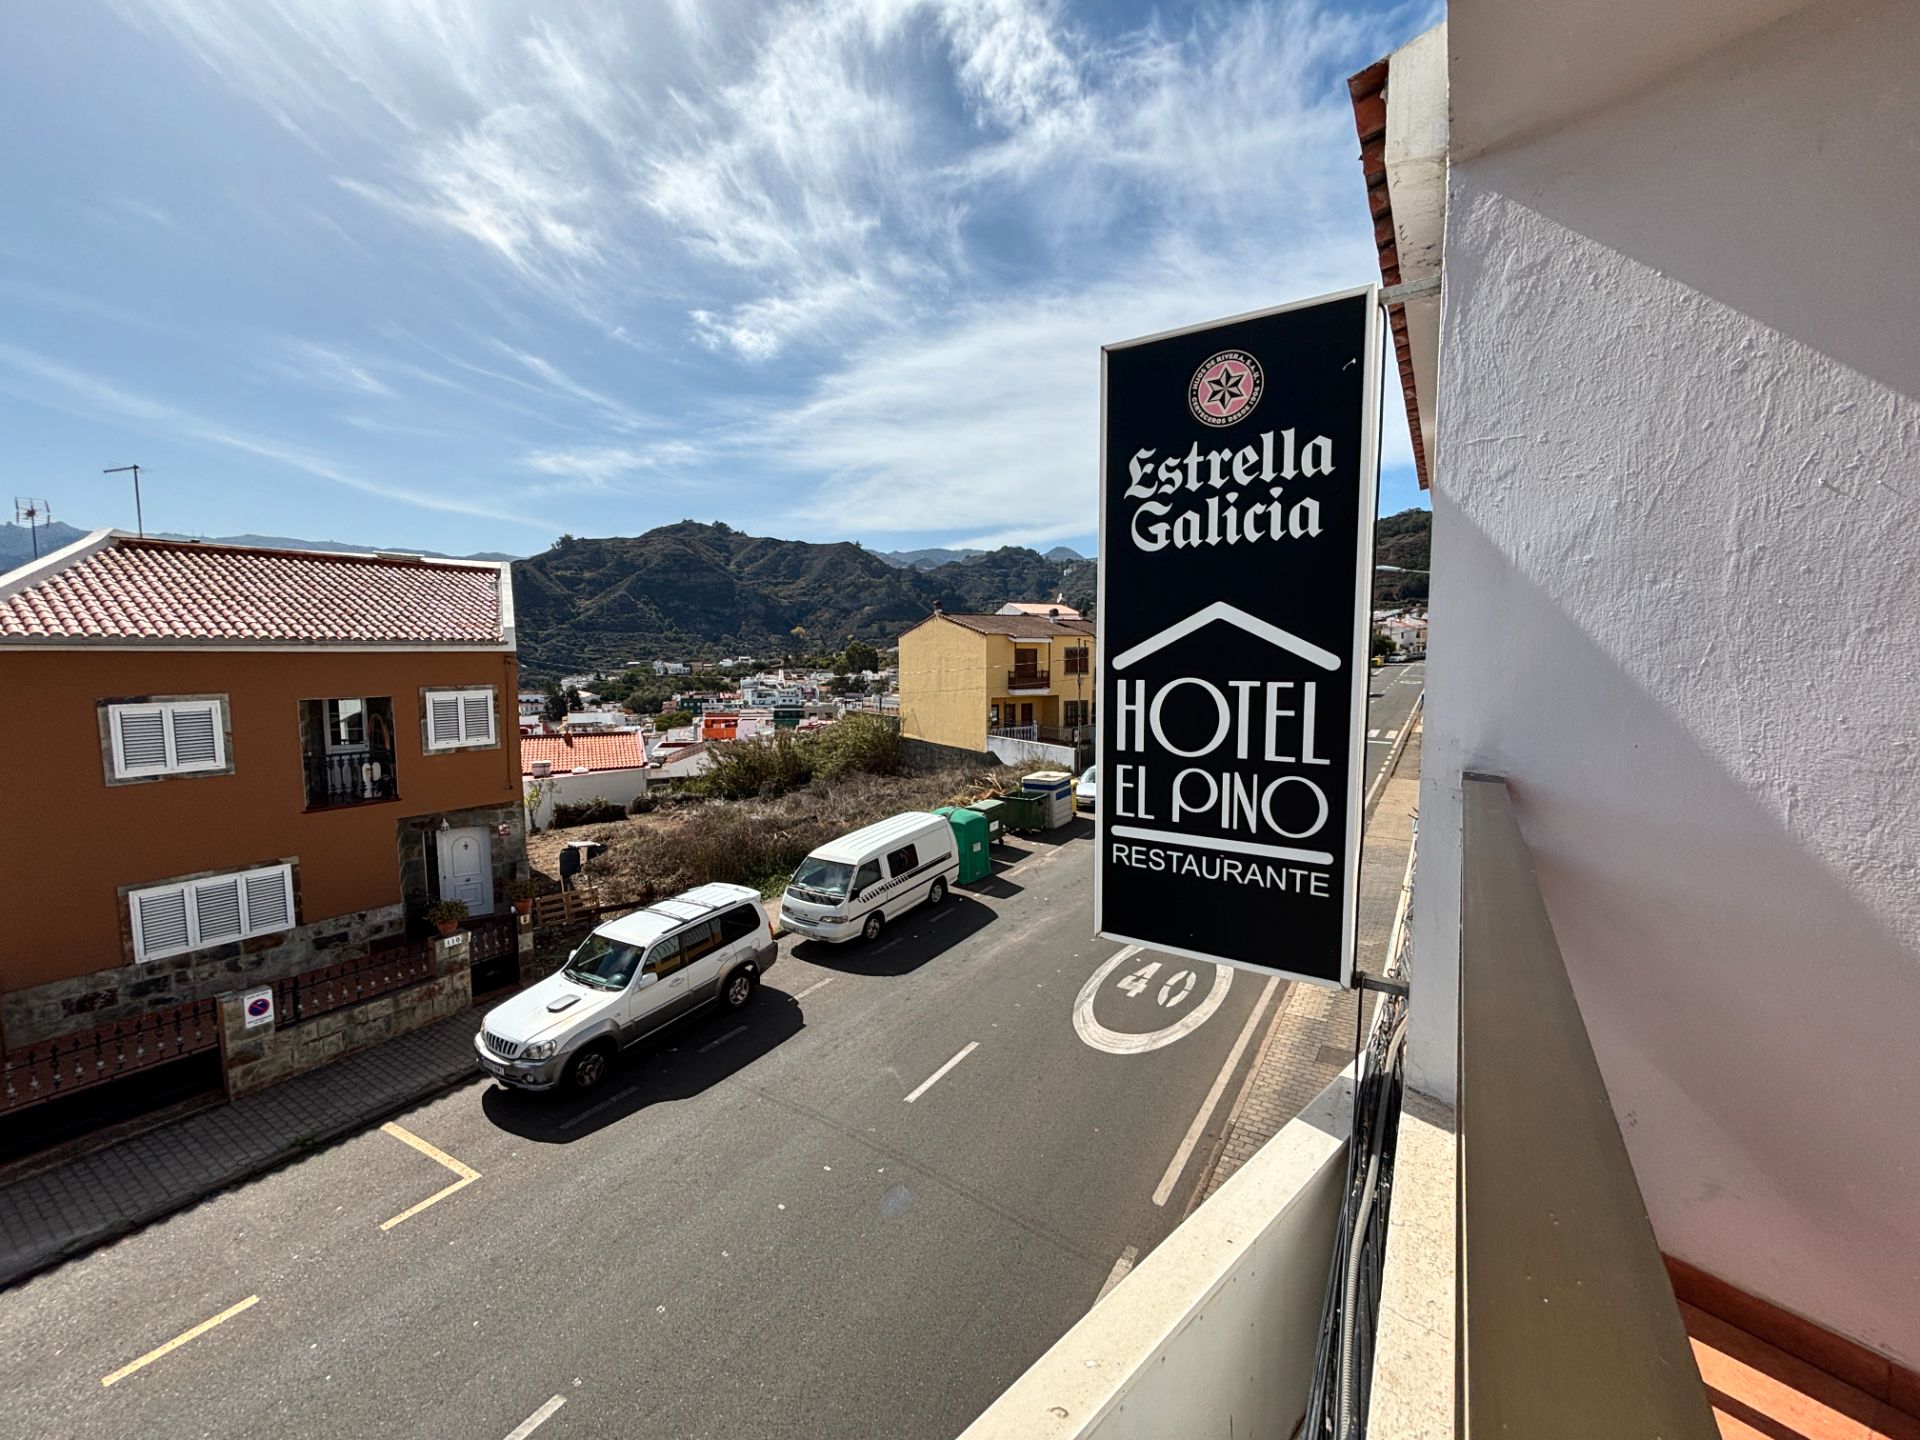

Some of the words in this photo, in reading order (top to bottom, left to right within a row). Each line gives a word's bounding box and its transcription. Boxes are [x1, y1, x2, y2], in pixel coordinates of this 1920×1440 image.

[1192, 368, 1207, 390] HIJOS
[1205, 359, 1216, 369] DE
[1191, 397, 1226, 425] CERVECEROS
[1227, 405, 1251, 423] DESDE
[1124, 427, 1336, 500] Estrella
[1131, 486, 1324, 552] Galicia
[1116, 677, 1331, 765] HOTEL
[1115, 764, 1155, 820] EL
[1171, 767, 1329, 839] PINO
[1112, 843, 1330, 898] RESTAURANTE
[1116, 962, 1197, 1008] 40
